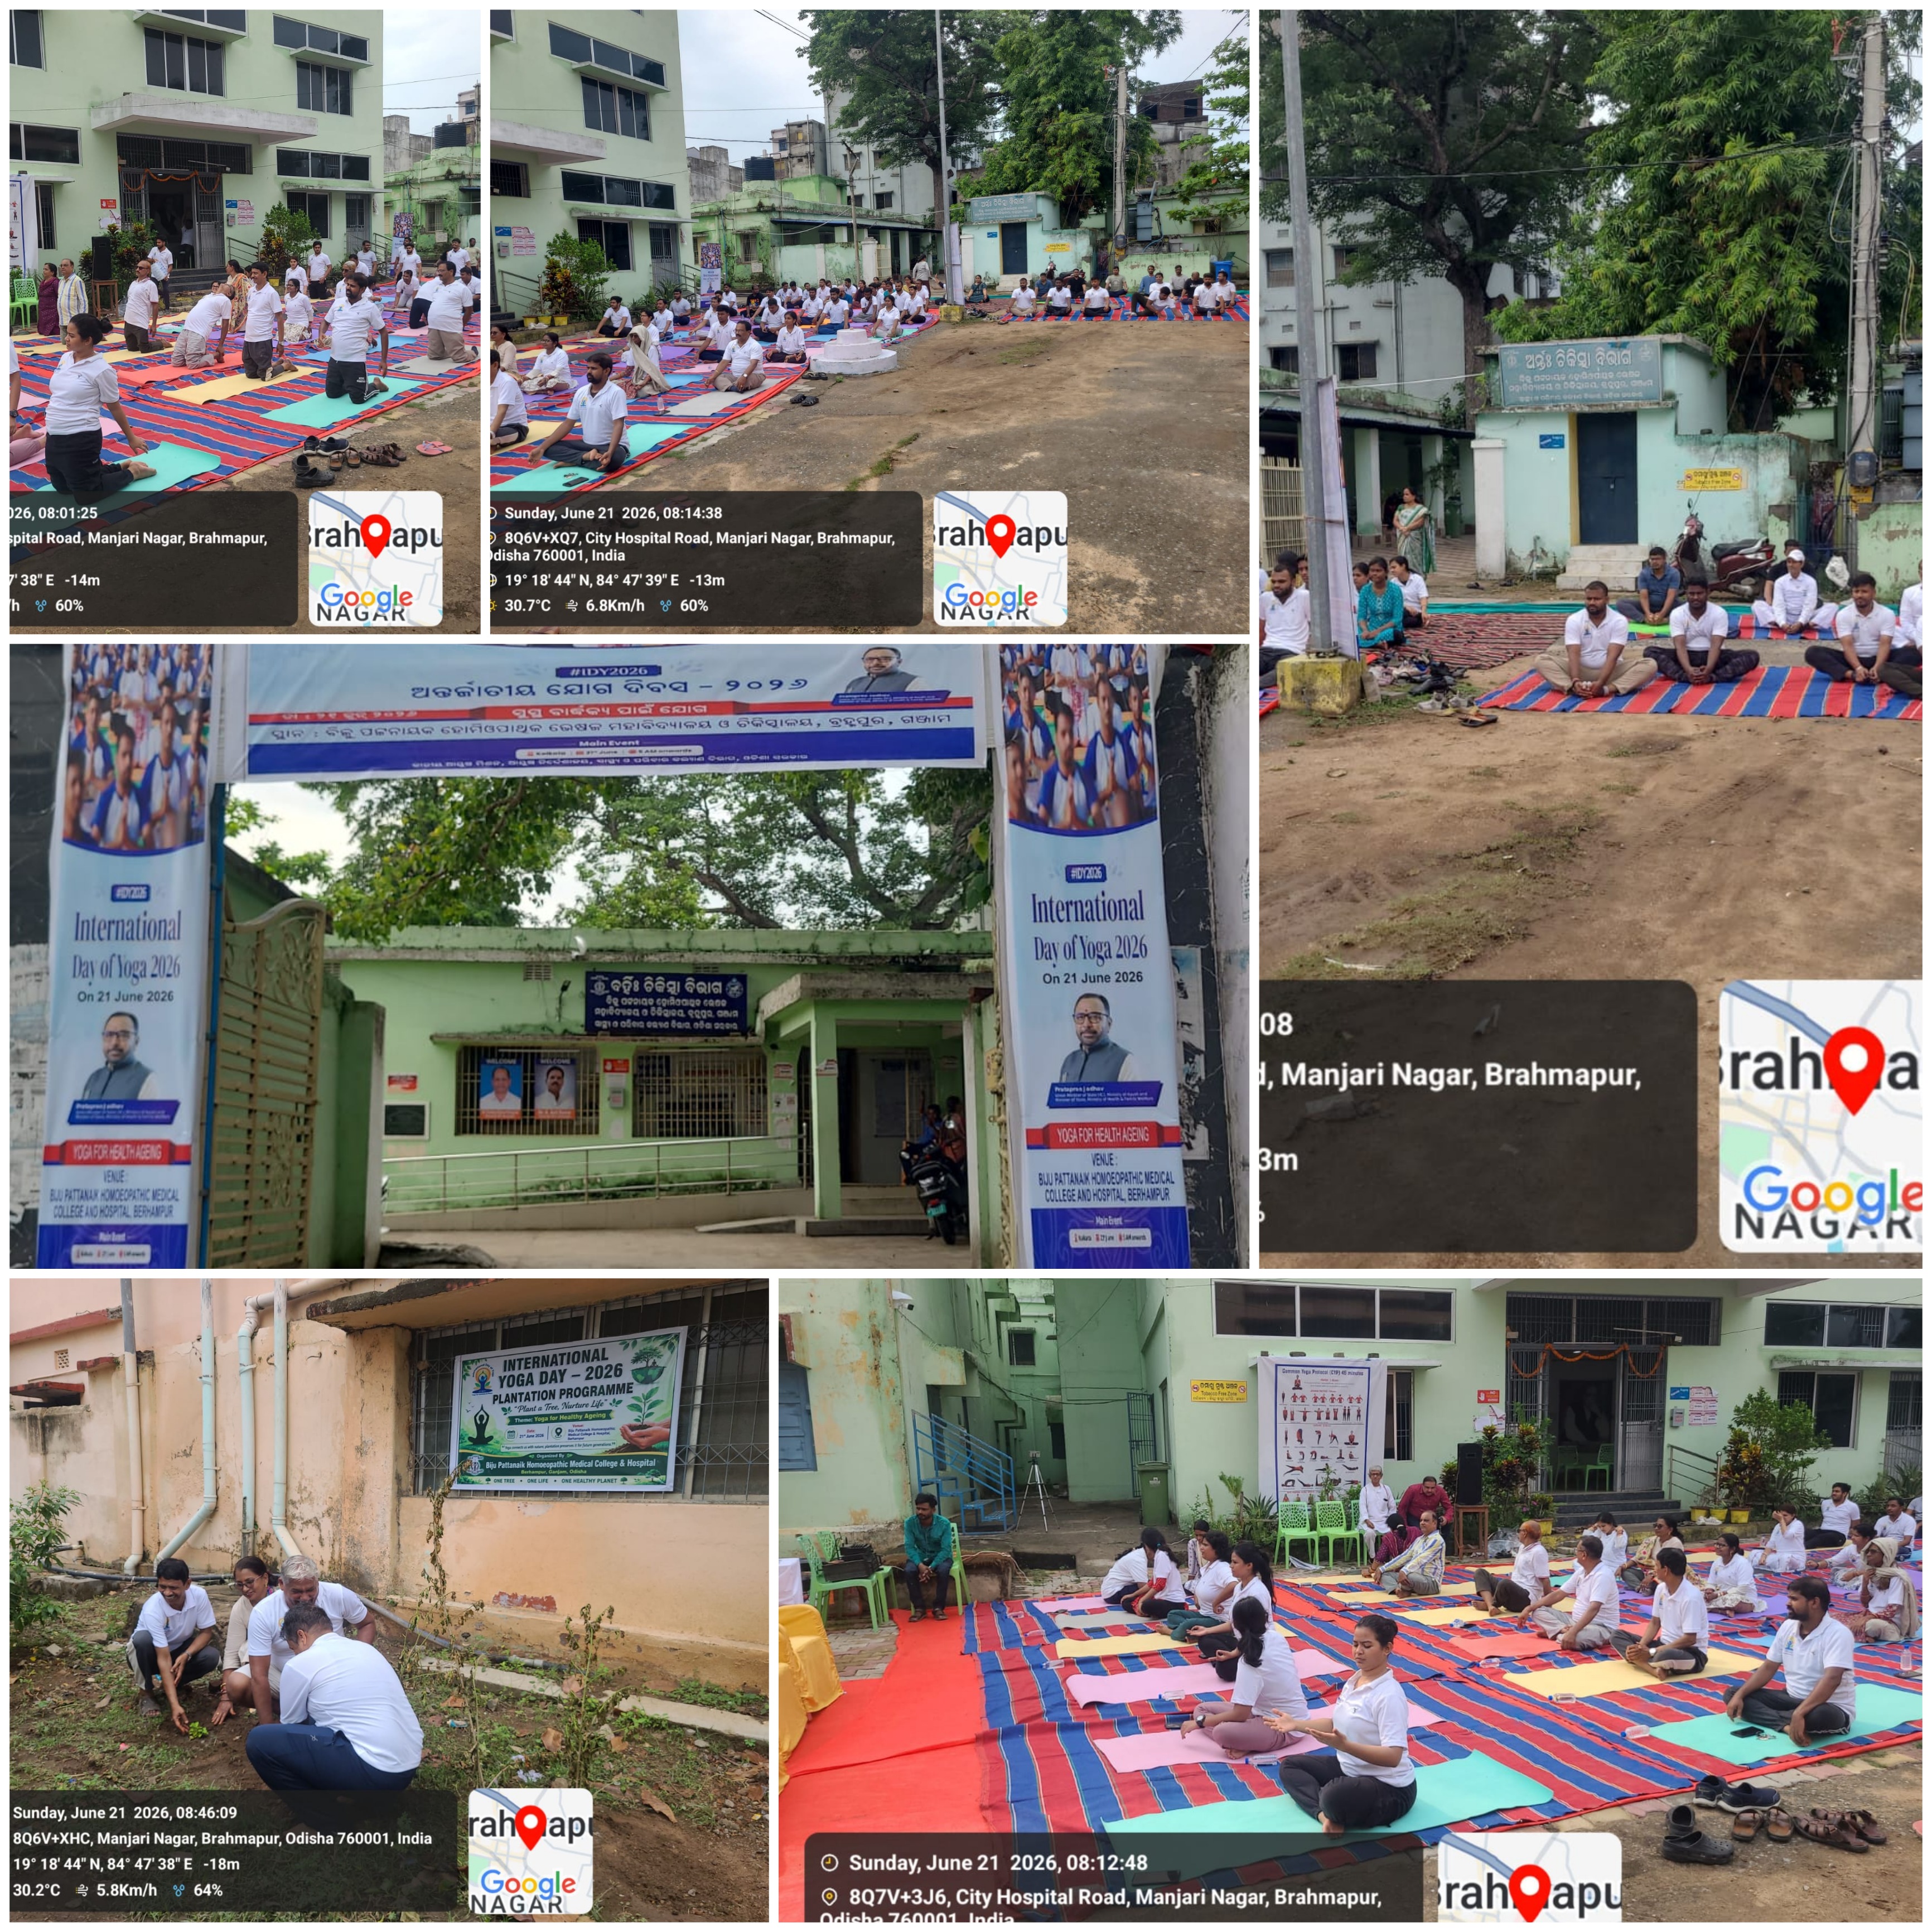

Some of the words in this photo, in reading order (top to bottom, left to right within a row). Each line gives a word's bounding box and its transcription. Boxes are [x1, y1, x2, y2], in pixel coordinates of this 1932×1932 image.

[1596, 347, 1631, 365] ବିଭାଗ
[571, 667, 648, 677] #IDY2026
[547, 682, 612, 695] ଯୋଗ
[624, 679, 688, 693] ଦିବସ
[726, 678, 808, 692] ୨୦୨୬
[659, 704, 707, 714] ଯୋଗ
[718, 719, 730, 728] ଓ
[1070, 867, 1102, 880] #IDY2026
[1031, 890, 1145, 923] International
[75, 910, 181, 941] International
[1034, 936, 1059, 969] Day
[1063, 934, 1078, 960] of
[1079, 934, 1112, 968] Yoga
[1115, 935, 1148, 959] 2026
[72, 954, 95, 986] Day
[100, 953, 117, 979] of
[117, 954, 147, 986] Yoga
[149, 954, 181, 978] 2026
[1042, 973, 1060, 984] On
[1063, 972, 1077, 984] 21
[1081, 972, 1111, 984] June
[1114, 971, 1143, 983] 2026
[684, 977, 723, 995] ବିଭାଗ
[77, 991, 94, 1003] On
[96, 991, 111, 1003] 21
[114, 991, 144, 1003] June
[146, 990, 175, 1002] 2026
[1057, 1128, 1078, 1143] YOGA
[1079, 1128, 1094, 1143] FOR
[1095, 1127, 1121, 1142] HEALTH
[1122, 1126, 1149, 1142] AGEING
[1091, 1153, 1115, 1167] VENUE
[1038, 1172, 1054, 1187] BIJU
[1055, 1172, 1089, 1186] PATTANAIK
[1091, 1171, 1143, 1186] HOMOEOPATHIC
[1144, 1171, 1175, 1185] MEDICAL
[1045, 1189, 1076, 1202] COLLEGE
[1077, 1189, 1092, 1202] AND
[1093, 1188, 1127, 1204] HOSPITAL,
[1128, 1187, 1170, 1201] BERHAMPUR
[503, 1347, 608, 1373] INTERNATIONAL
[498, 1373, 534, 1389] YOGA
[539, 1368, 567, 1385] DAY
[585, 1363, 624, 1381] 2026
[492, 1389, 556, 1405] PLANTATION
[559, 1382, 634, 1400] PROGRAMME
[544, 1403, 559, 1411] Tree,
[562, 1401, 590, 1409] Nurture
[486, 1461, 496, 1470] Biju
[527, 1460, 568, 1469] Homoeopathic
[569, 1459, 593, 1468] Medical
[595, 1459, 618, 1469] College
[627, 1458, 656, 1468] Hospital
